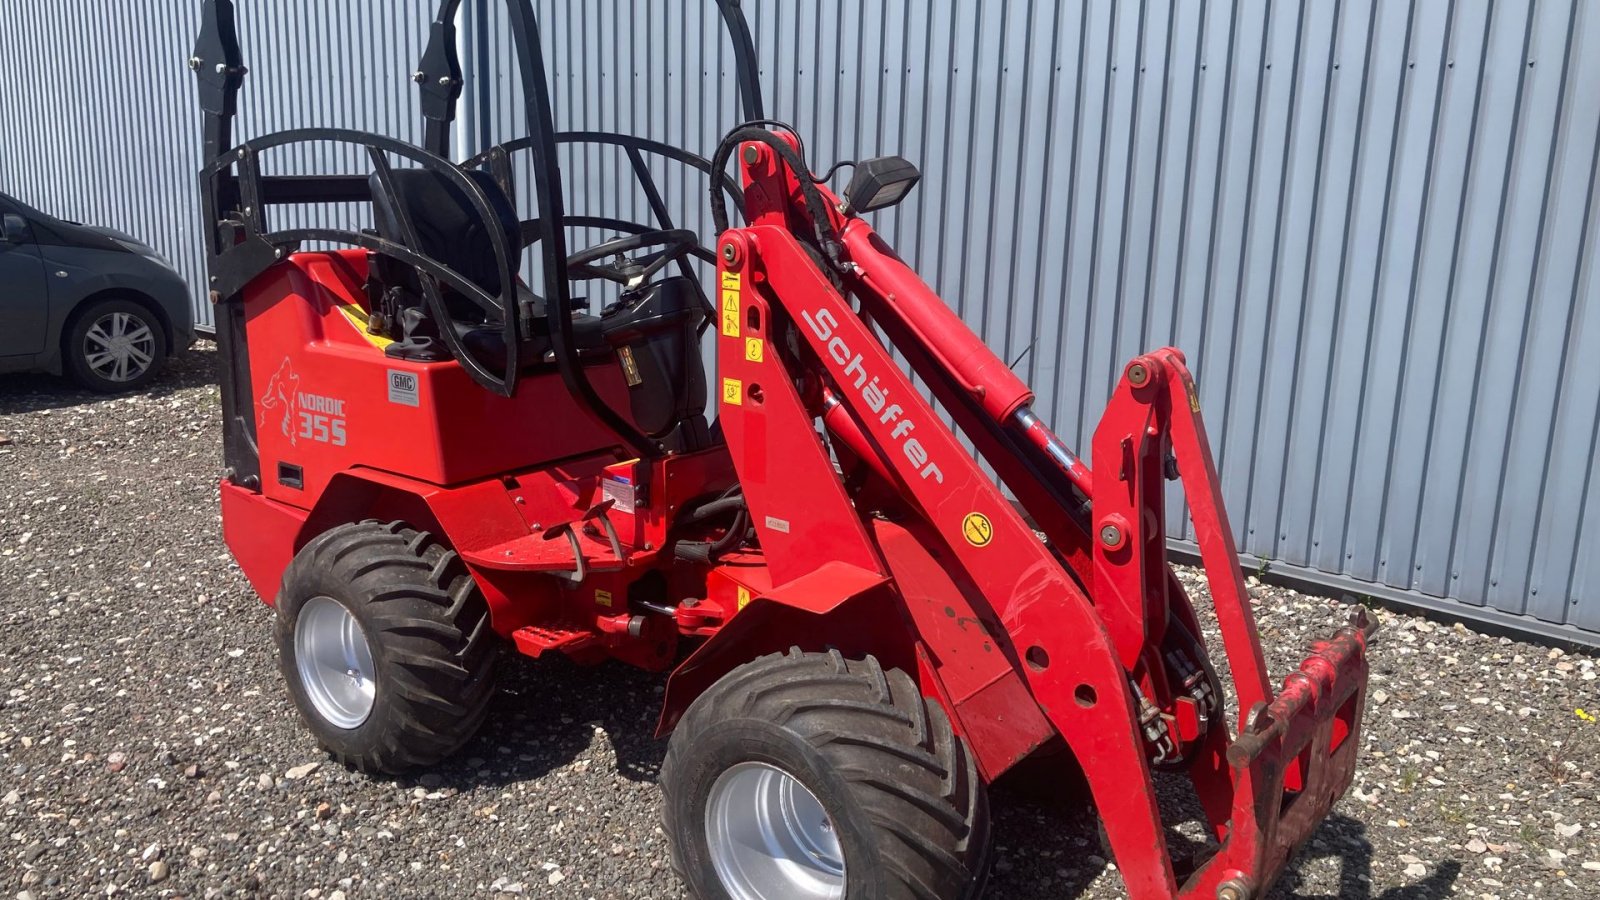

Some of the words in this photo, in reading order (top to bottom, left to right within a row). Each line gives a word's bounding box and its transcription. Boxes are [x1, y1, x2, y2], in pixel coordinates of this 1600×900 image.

[394, 374, 412, 390] GMC
[298, 391, 346, 417] NORDIC
[801, 308, 944, 485] Schäffer
